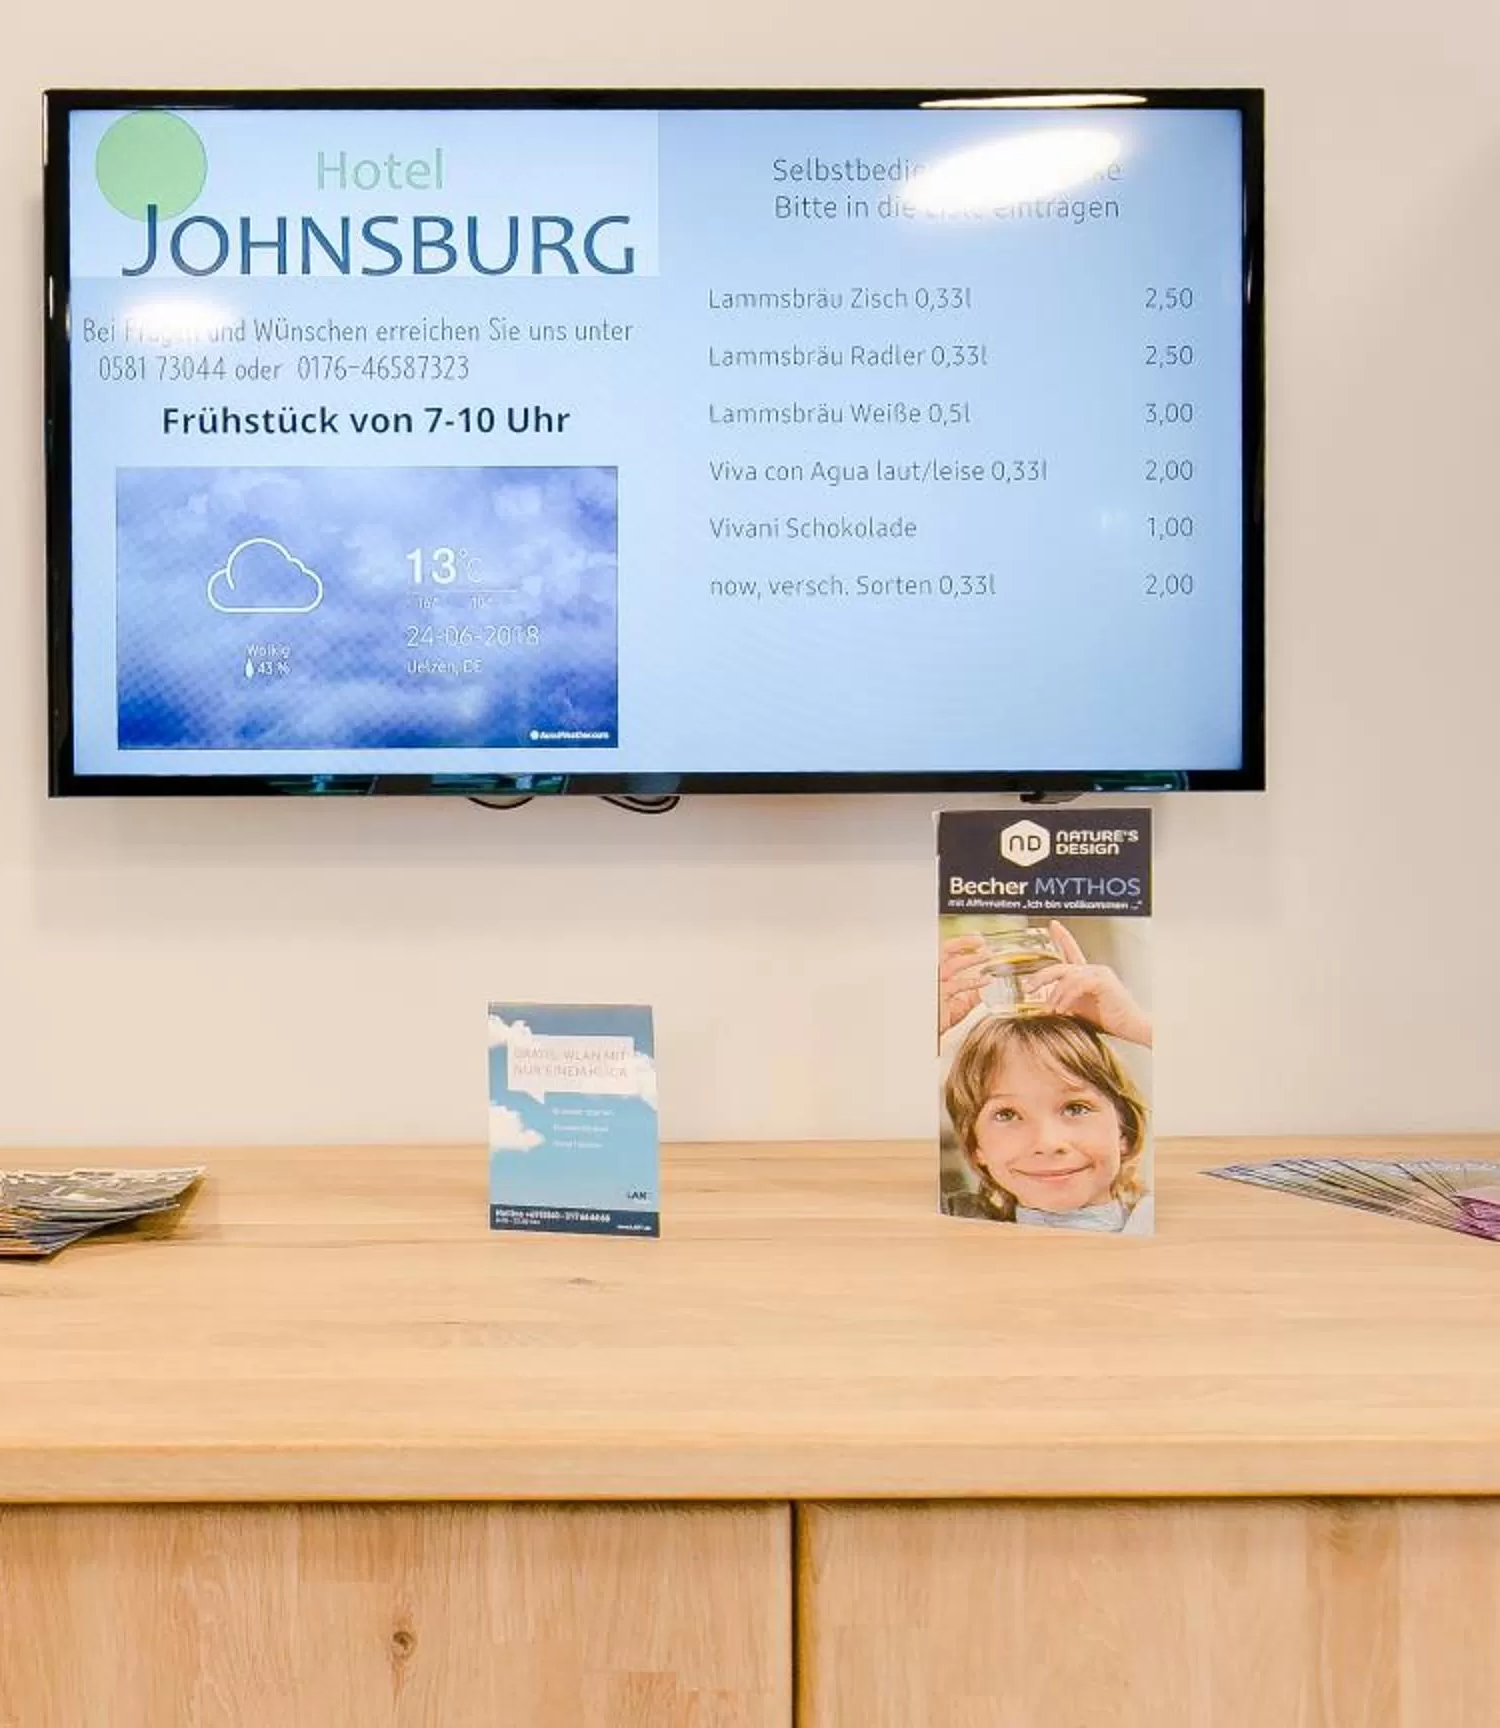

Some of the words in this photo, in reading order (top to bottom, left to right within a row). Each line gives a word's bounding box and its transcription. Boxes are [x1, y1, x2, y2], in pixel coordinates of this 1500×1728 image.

[316, 147, 444, 190] Hotel
[774, 195, 837, 219] Bitte
[847, 195, 869, 219] in
[878, 195, 915, 219] die
[121, 203, 635, 277] JOHNSBURG
[708, 288, 843, 310] Lammsbräu
[851, 288, 907, 310] Zisch
[915, 288, 971, 313] 0,33l
[1145, 288, 1193, 313] 2,50
[83, 317, 115, 342] Bei
[209, 319, 246, 342] und
[254, 317, 367, 343] Wünschen
[376, 319, 480, 342] erreichen
[488, 317, 520, 342] Sie
[529, 323, 567, 342] uns
[576, 320, 634, 342] unter
[99, 356, 146, 381] 0581
[156, 356, 226, 381] 73044
[235, 356, 282, 381] oder
[297, 356, 469, 381] 0176-46587323
[708, 345, 843, 367] Lammsbräu
[851, 345, 925, 367] Radler
[931, 345, 987, 371] 0,33l
[1145, 345, 1193, 371] 2,50
[162, 406, 339, 434] Frühstück
[351, 413, 413, 434] von
[425, 408, 494, 433] 7-10
[507, 406, 571, 433] Uhr
[708, 403, 843, 424] Lammsbräu
[851, 403, 921, 424] Weiße
[928, 403, 971, 428] 0,5l
[1145, 403, 1193, 427] 3,00
[710, 460, 756, 481] Viva
[765, 466, 803, 481] con
[811, 461, 869, 486] Agua
[877, 460, 984, 482] laut/leise
[991, 460, 1048, 484] 0,33l
[1145, 461, 1193, 484] 2,00
[710, 517, 779, 538] Vivani
[786, 517, 917, 538] Schokolade
[1148, 517, 1193, 541] 1,00
[710, 580, 762, 599] now,
[768, 574, 849, 596] versch.
[857, 574, 931, 596] Sorten
[938, 574, 996, 599] 0,33l
[1145, 574, 1193, 599] 2,00
[407, 625, 539, 648] 24-06-2018
[1056, 844, 1119, 855] DESIGN
[950, 877, 1028, 895] Becher
[1035, 877, 1140, 897] MYTHOS
[1045, 901, 1061, 909] bin
